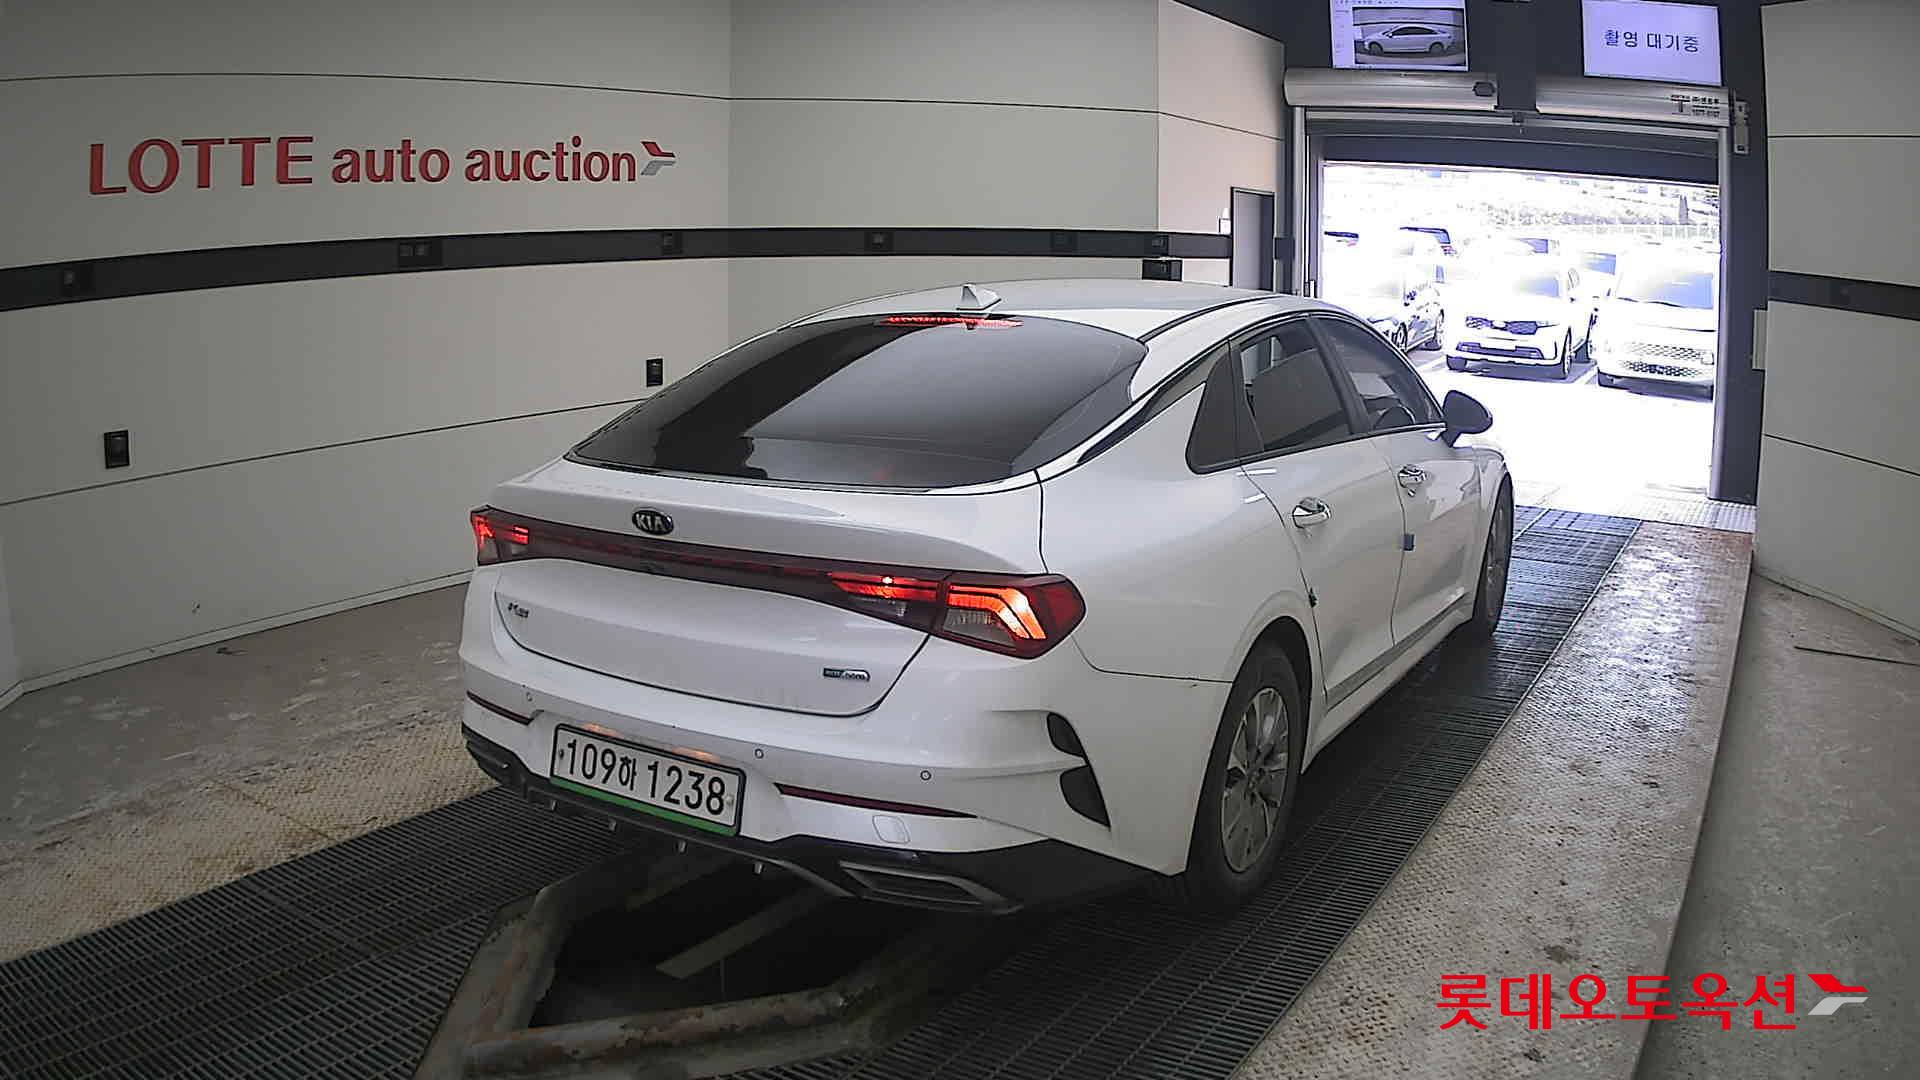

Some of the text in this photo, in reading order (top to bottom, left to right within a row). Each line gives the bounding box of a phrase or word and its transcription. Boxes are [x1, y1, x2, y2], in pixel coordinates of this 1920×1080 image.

[1603, 29, 1699, 53] 촬영 대기중
[89, 135, 636, 195] LOTTE auto auction
[635, 513, 667, 532] KIA
[567, 739, 726, 815] 109하 1238
